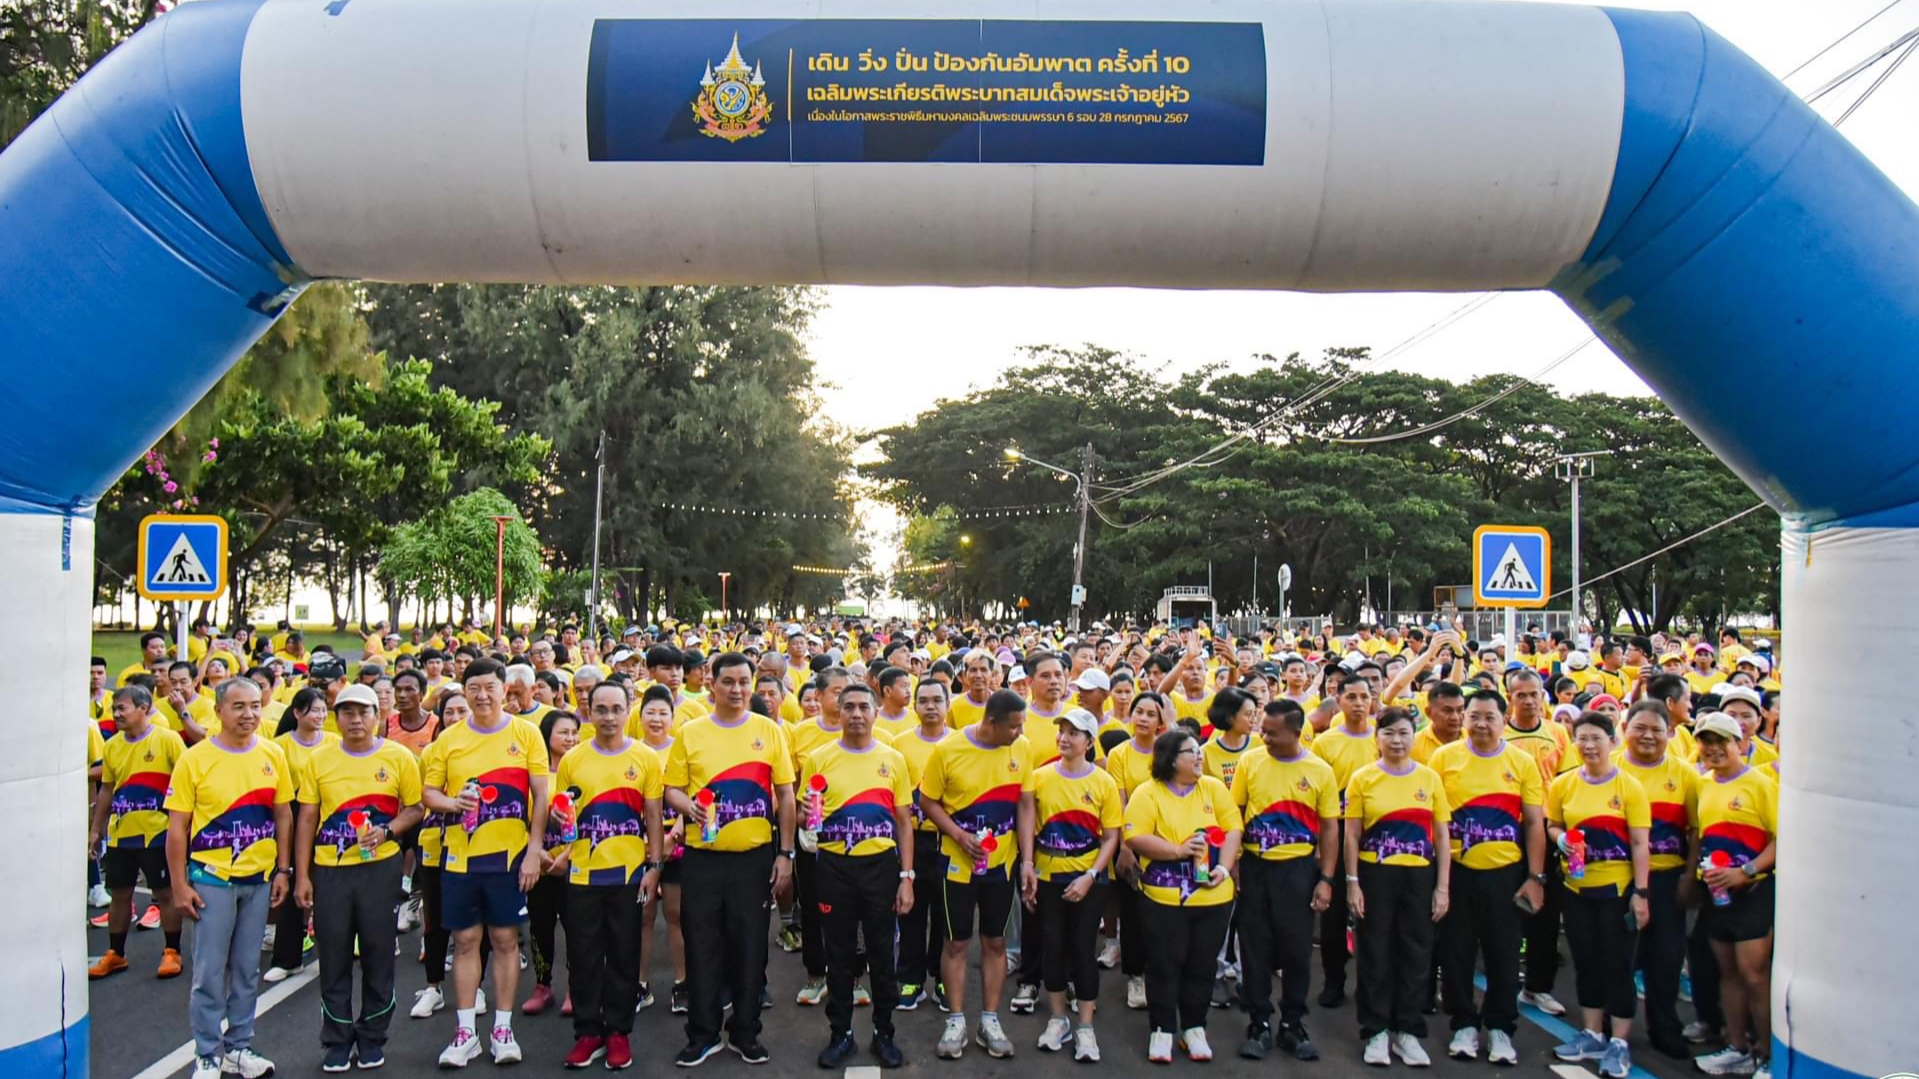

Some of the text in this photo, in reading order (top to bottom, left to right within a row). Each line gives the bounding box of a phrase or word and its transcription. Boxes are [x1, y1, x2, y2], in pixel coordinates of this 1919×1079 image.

[808, 47, 1190, 73] เดิน วิ่ง ปั่น ป้องกันอัมพาต ครั้งที่ 10
[807, 82, 1190, 108] เฉลิมพระเกียรติพระบาทสมเด็จพระเจ้าอยู่หัว
[808, 109, 1189, 125] เนื่องในโอกาสพระราชพิธีมหามงคลเฉลิมพระชนมพรรษา 6 รอบ 28 กรกฎาคม 2567
